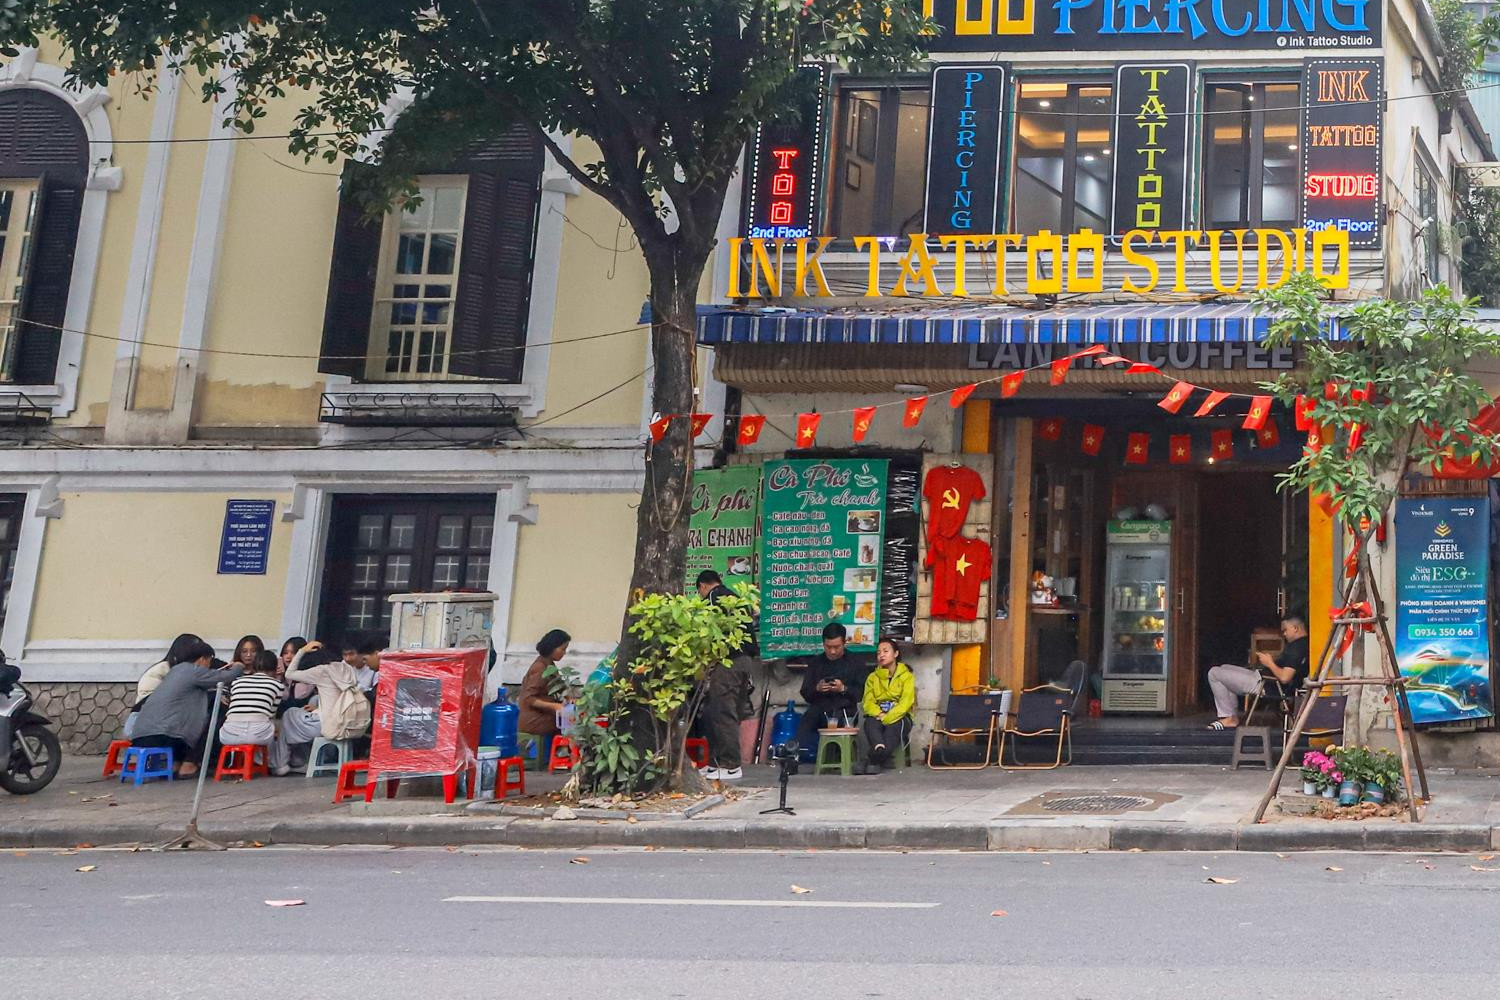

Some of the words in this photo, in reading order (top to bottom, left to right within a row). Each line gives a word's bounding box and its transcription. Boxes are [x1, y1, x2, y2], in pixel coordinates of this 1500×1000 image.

[1289, 36, 1305, 47] Ink
[1307, 36, 1339, 47] Tattoo
[1340, 35, 1373, 46] Studio
[1317, 70, 1370, 102] INK
[1309, 125, 1376, 147] TATTOO
[950, 72, 984, 229] PIERCING
[1135, 69, 1169, 227] TATTOO
[1307, 174, 1376, 197] STUDIO
[752, 227, 775, 238] 2nd
[777, 227, 808, 238] Floor
[1336, 218, 1375, 232] Floor
[727, 236, 835, 299] INK
[853, 228, 1104, 298] TATTOO
[1121, 228, 1350, 296] STUDIO
[1139, 342, 1294, 369] COFFEE
[1422, 552, 1465, 561] PARADISE
[1428, 544, 1458, 552] GREEN
[1415, 628, 1437, 636] 0934
[1440, 628, 1456, 636] 350
[1458, 628, 1473, 636] 666
